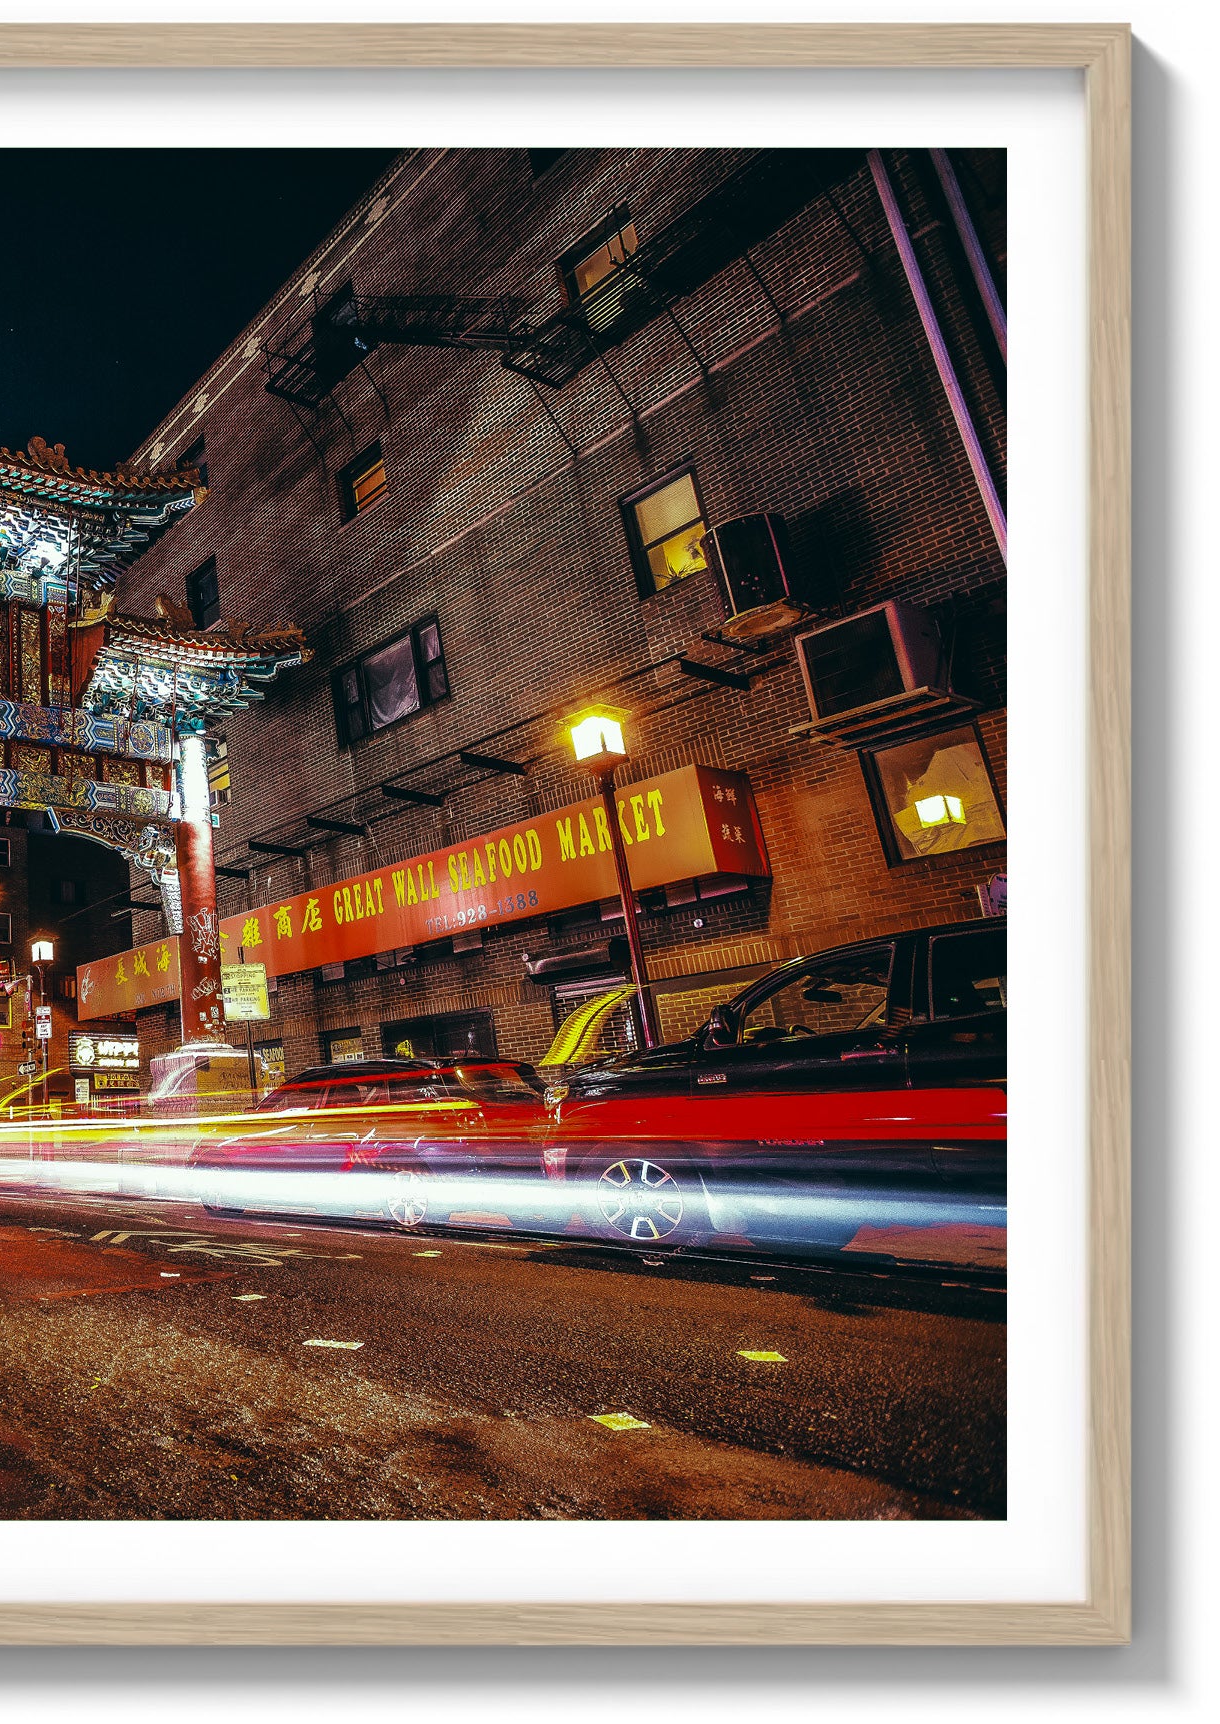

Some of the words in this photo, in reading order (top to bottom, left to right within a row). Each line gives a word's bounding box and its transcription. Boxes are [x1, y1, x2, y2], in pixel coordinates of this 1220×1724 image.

[333, 877, 385, 925] GREAT
[391, 860, 440, 908] WALL
[447, 828, 543, 895] SEAFOOD
[556, 788, 667, 862] MARKET
